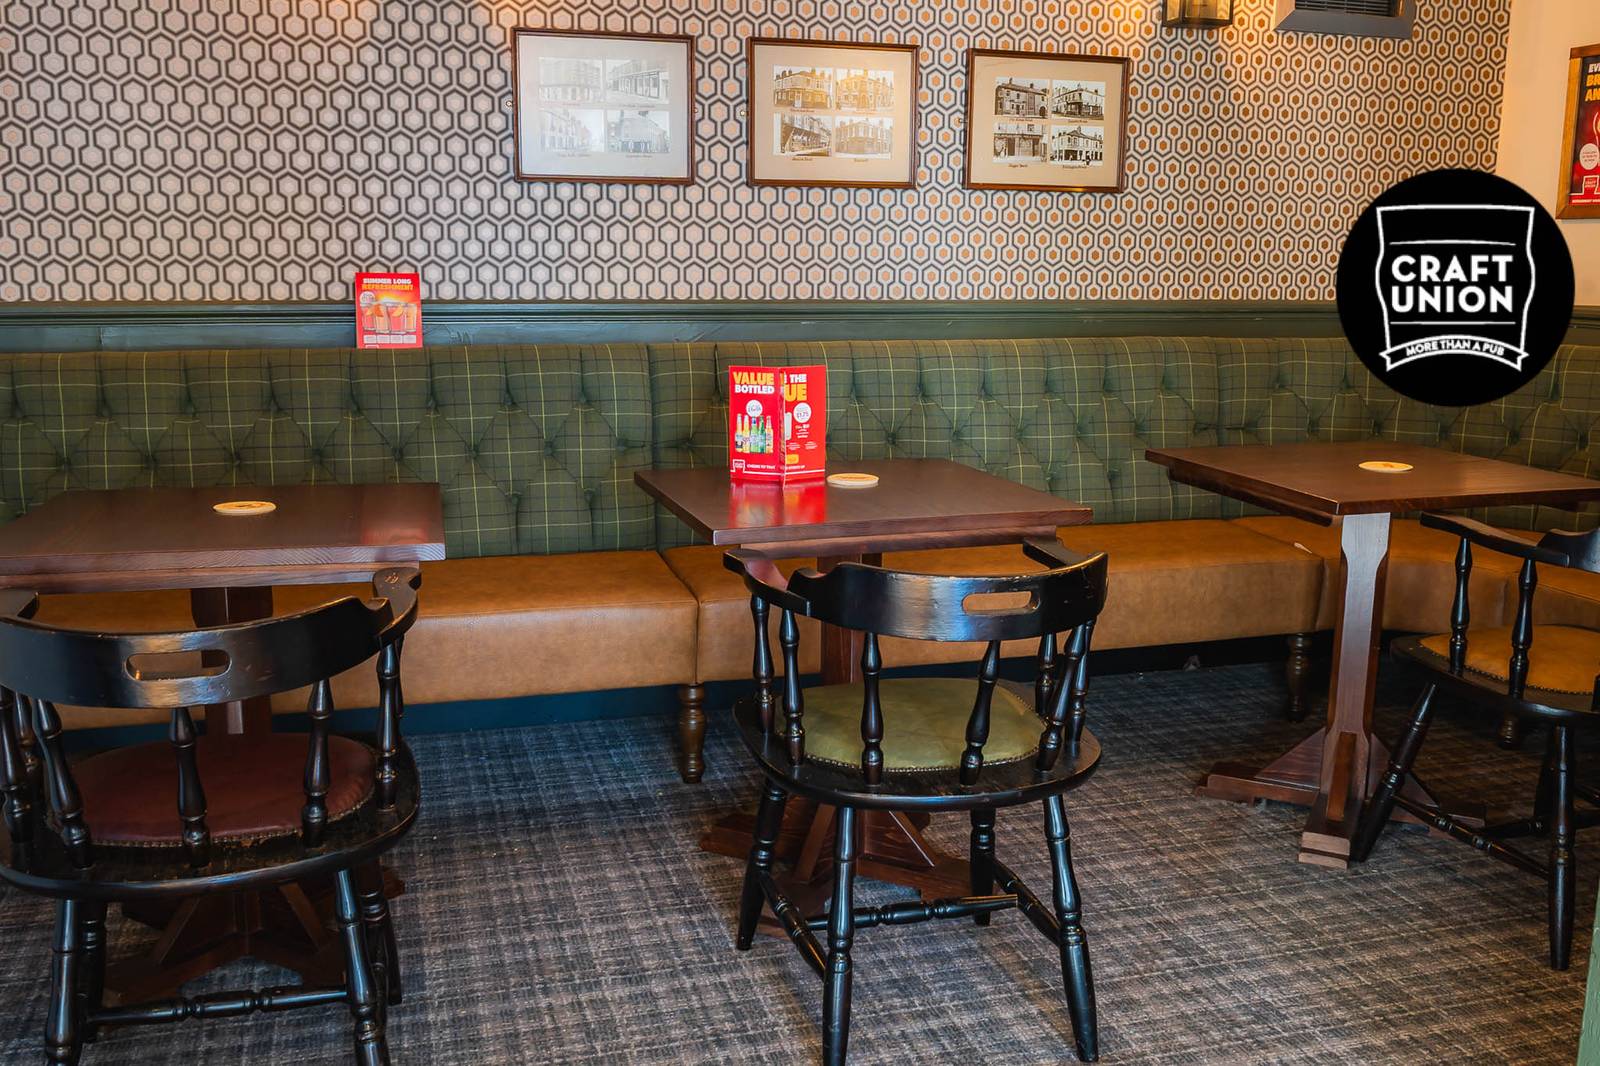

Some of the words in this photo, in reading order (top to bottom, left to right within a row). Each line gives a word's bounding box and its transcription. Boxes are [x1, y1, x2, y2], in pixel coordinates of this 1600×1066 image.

[733, 372, 774, 385] VALUE
[790, 374, 807, 383] THE
[735, 385, 774, 394] BOTTLED
[784, 384, 807, 401] UE
